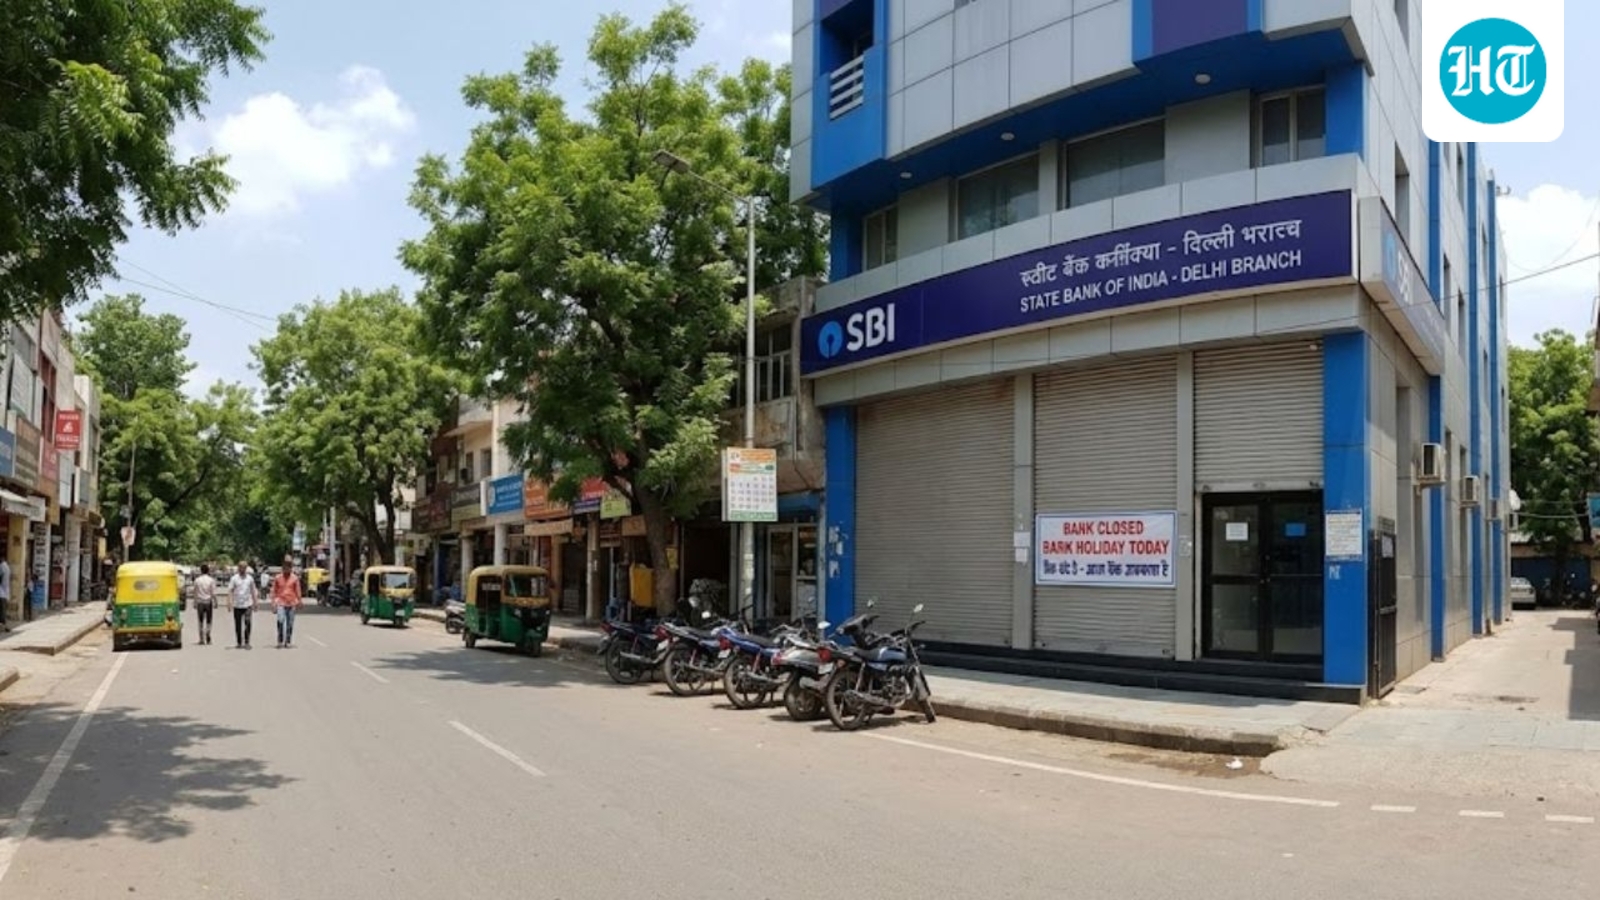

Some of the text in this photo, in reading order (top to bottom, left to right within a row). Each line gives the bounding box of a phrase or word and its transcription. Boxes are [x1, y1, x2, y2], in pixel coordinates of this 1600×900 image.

[1182, 223, 1235, 255] दिल्ली
[1020, 294, 1061, 312] STATE
[1063, 283, 1101, 304] BANK
[1105, 279, 1125, 296] OF
[1128, 267, 1168, 291] INDIA
[1181, 258, 1227, 283] DELHI
[1231, 249, 1302, 276] BRANCH
[846, 303, 895, 352] SBI
[1063, 520, 1144, 535] BANK CLOSED
[1076, 540, 1125, 555] HOLIDAY
[1129, 540, 1170, 555] TODAY
